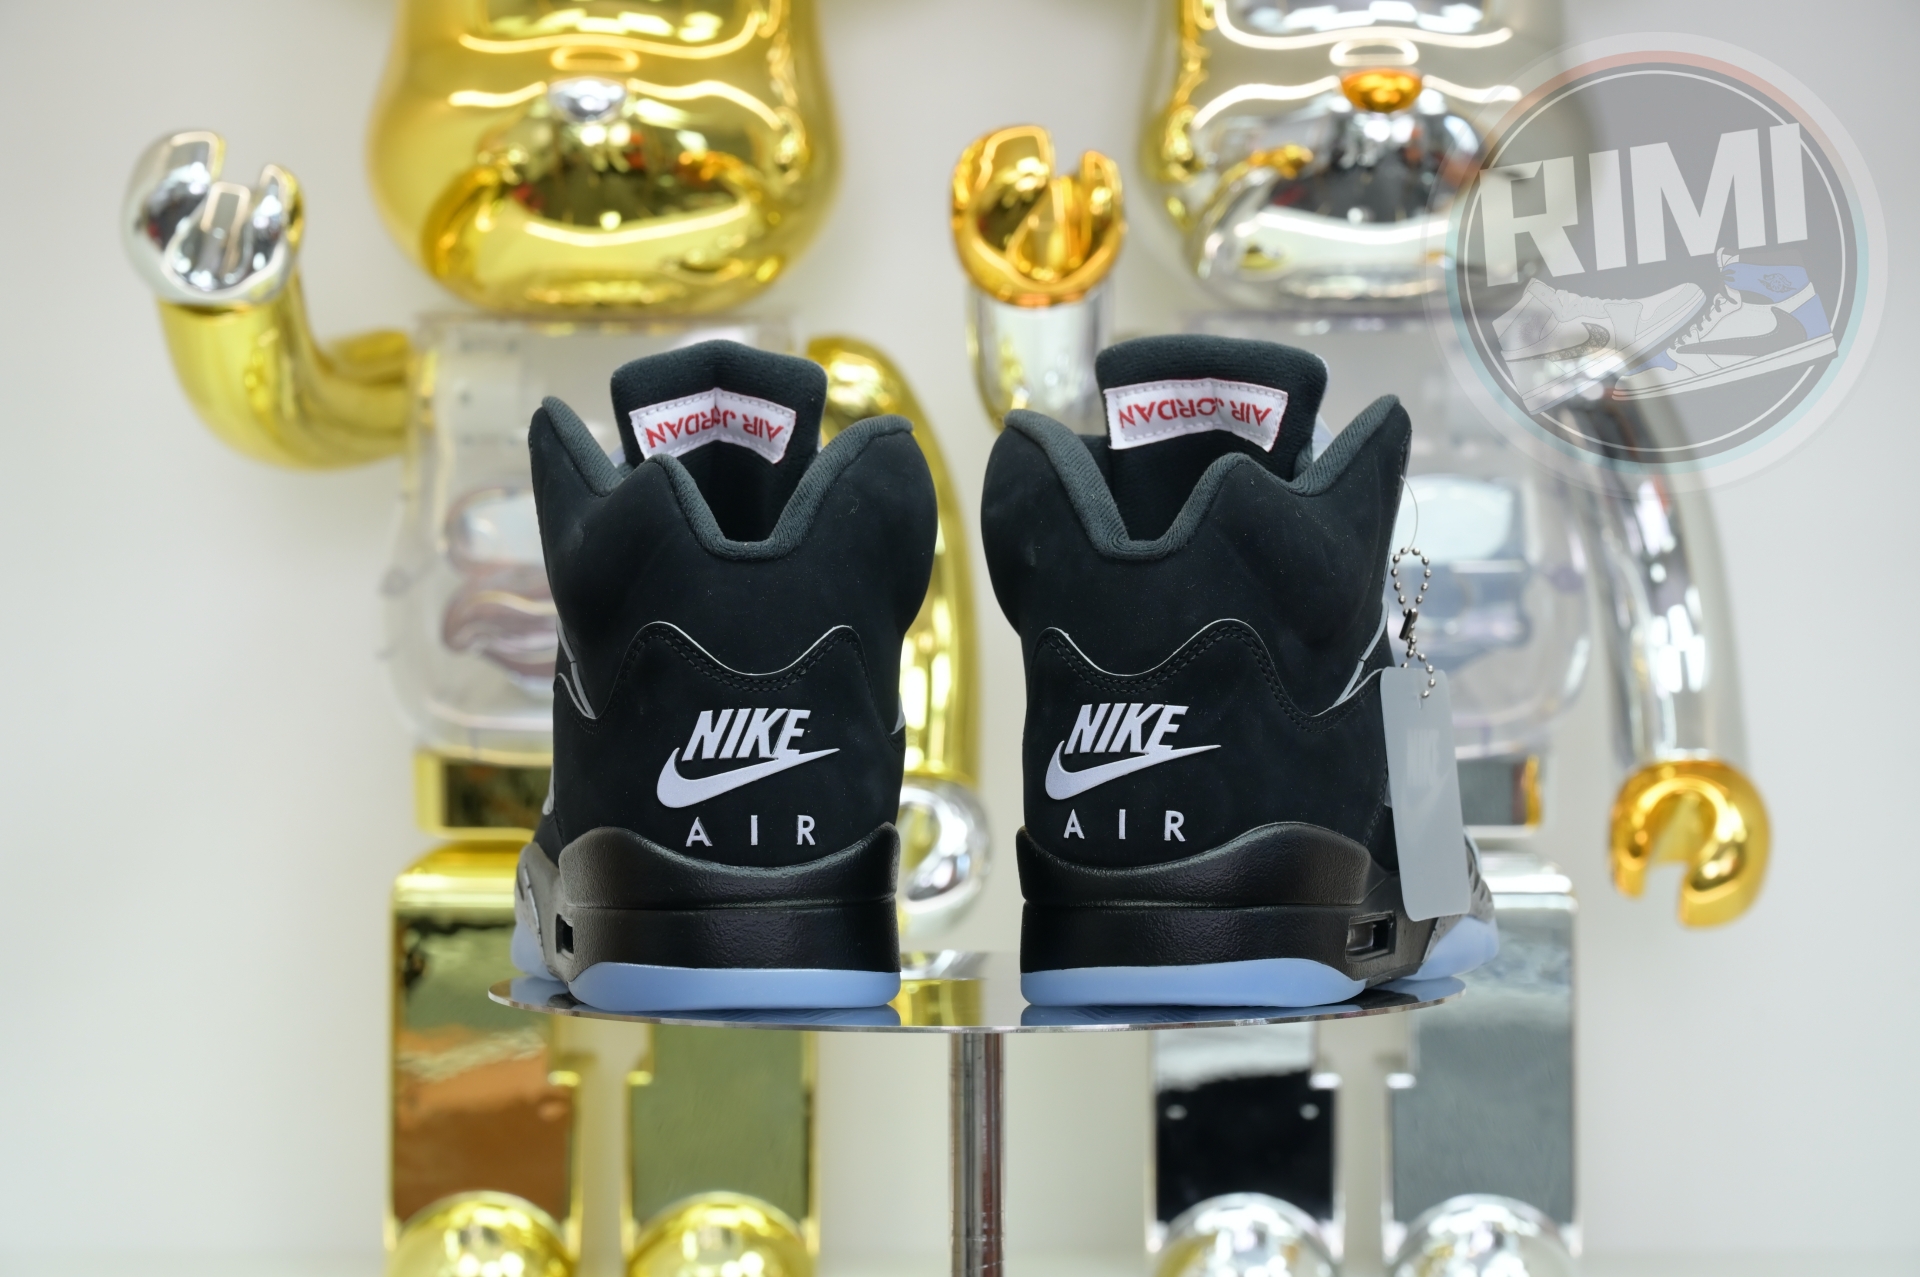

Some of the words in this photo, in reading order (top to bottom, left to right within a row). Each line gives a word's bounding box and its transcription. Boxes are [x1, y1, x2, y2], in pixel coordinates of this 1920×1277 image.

[743, 414, 785, 443] AIR
[1231, 401, 1273, 427] AIR
[682, 707, 812, 761] NIKE
[1064, 702, 1189, 755] NIKE
[686, 814, 816, 847] AIR
[1063, 808, 1186, 842] AIR
